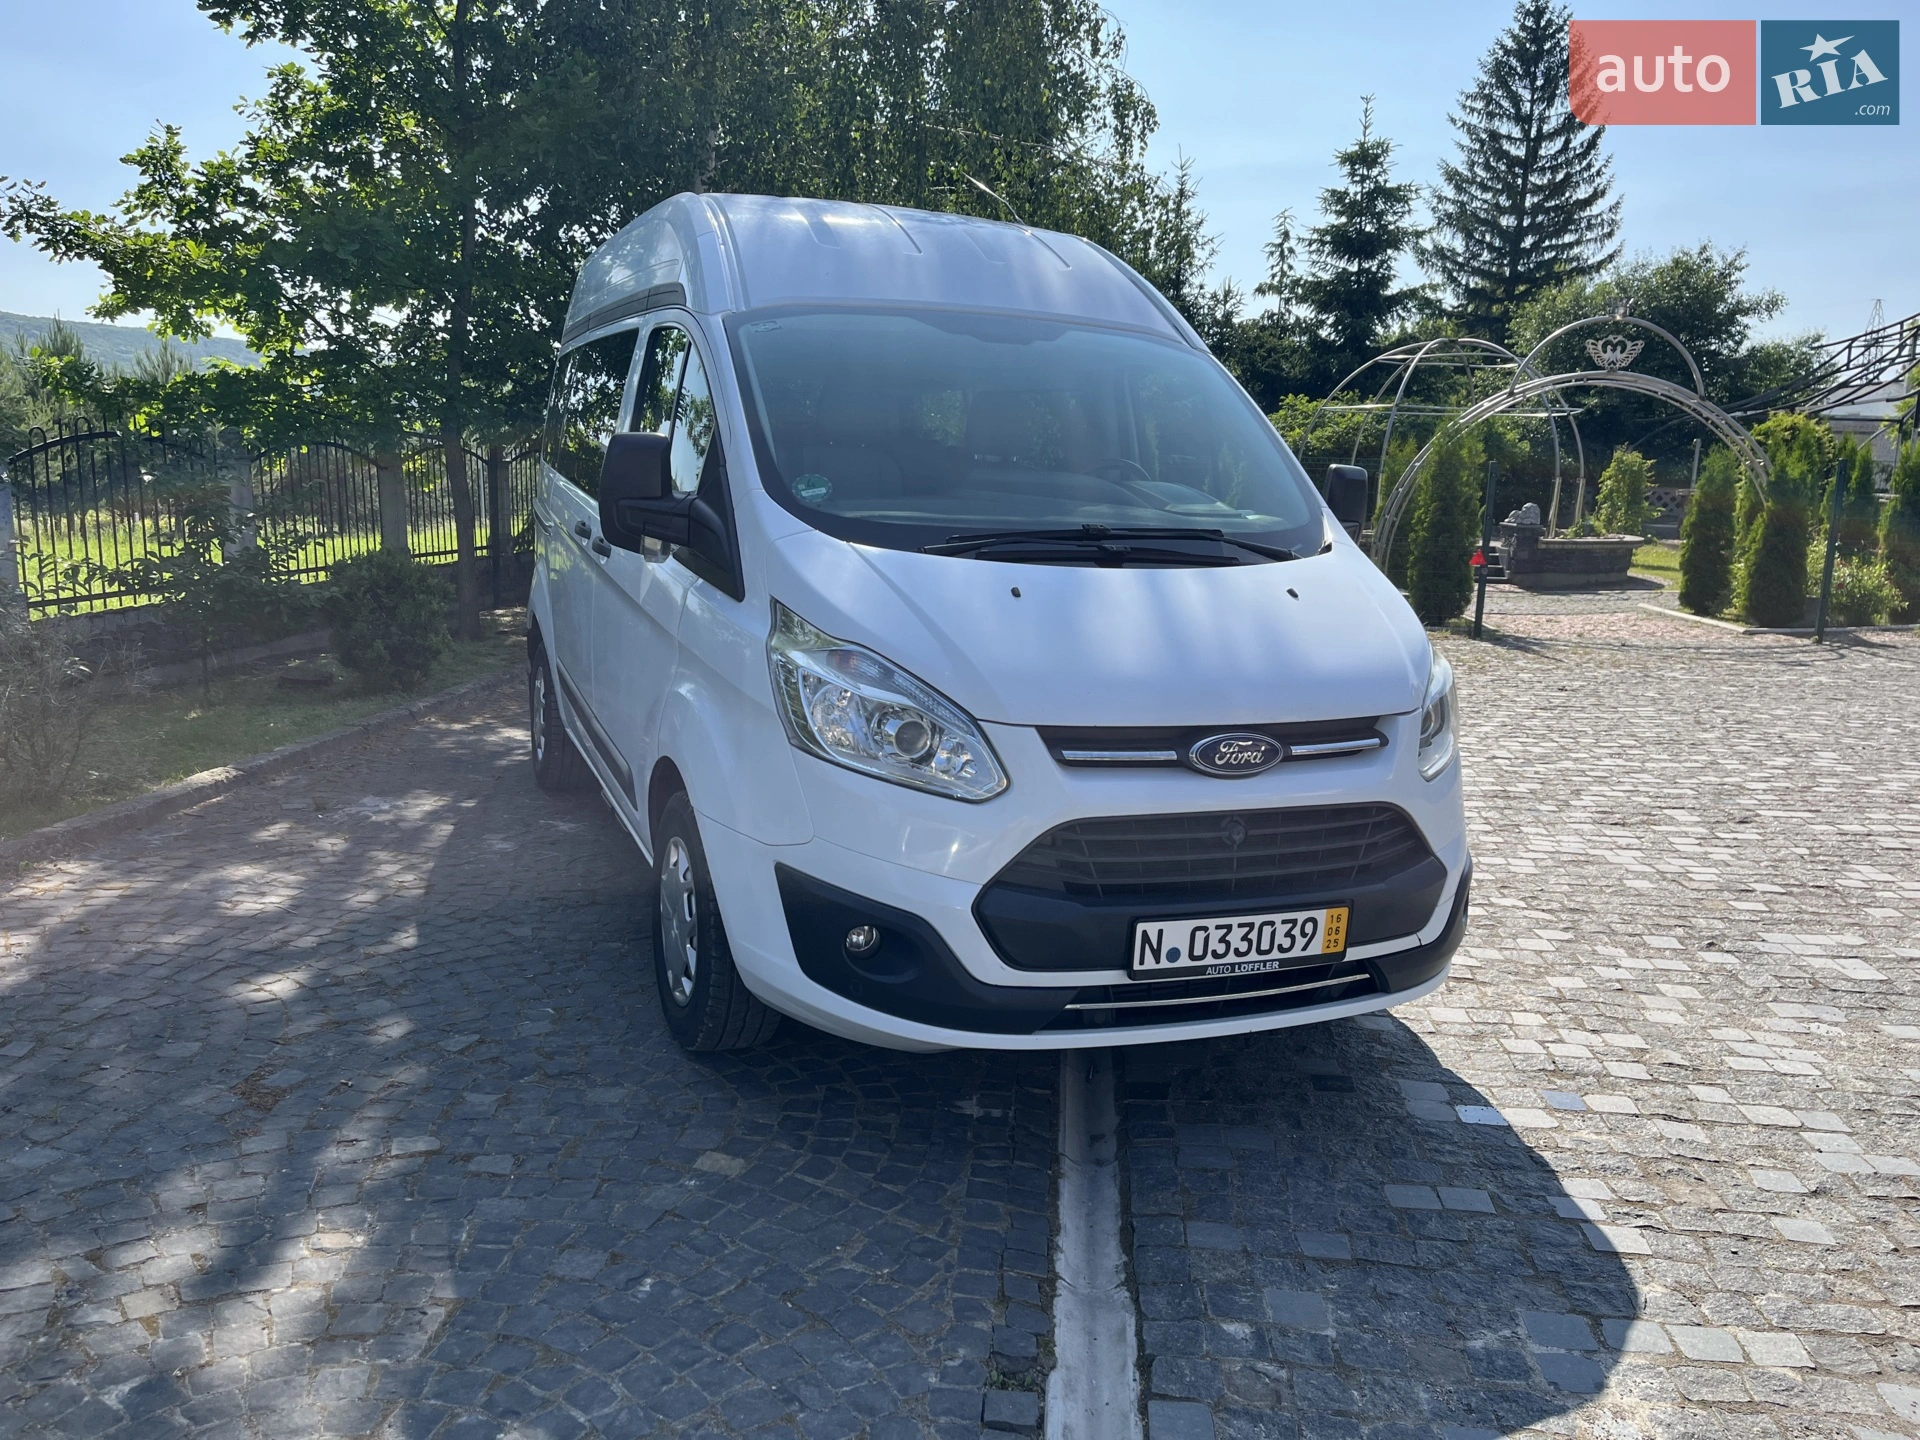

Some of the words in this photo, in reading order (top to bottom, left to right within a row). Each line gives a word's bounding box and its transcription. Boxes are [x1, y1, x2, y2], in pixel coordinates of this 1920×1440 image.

[1215, 740, 1265, 765] Ford
[1330, 914, 1342, 923] 16
[1327, 926, 1340, 936] 06
[1139, 929, 1163, 965] N
[1188, 917, 1319, 962] 033039
[1326, 939, 1339, 949] 25
[1206, 964, 1231, 975] AUTO
